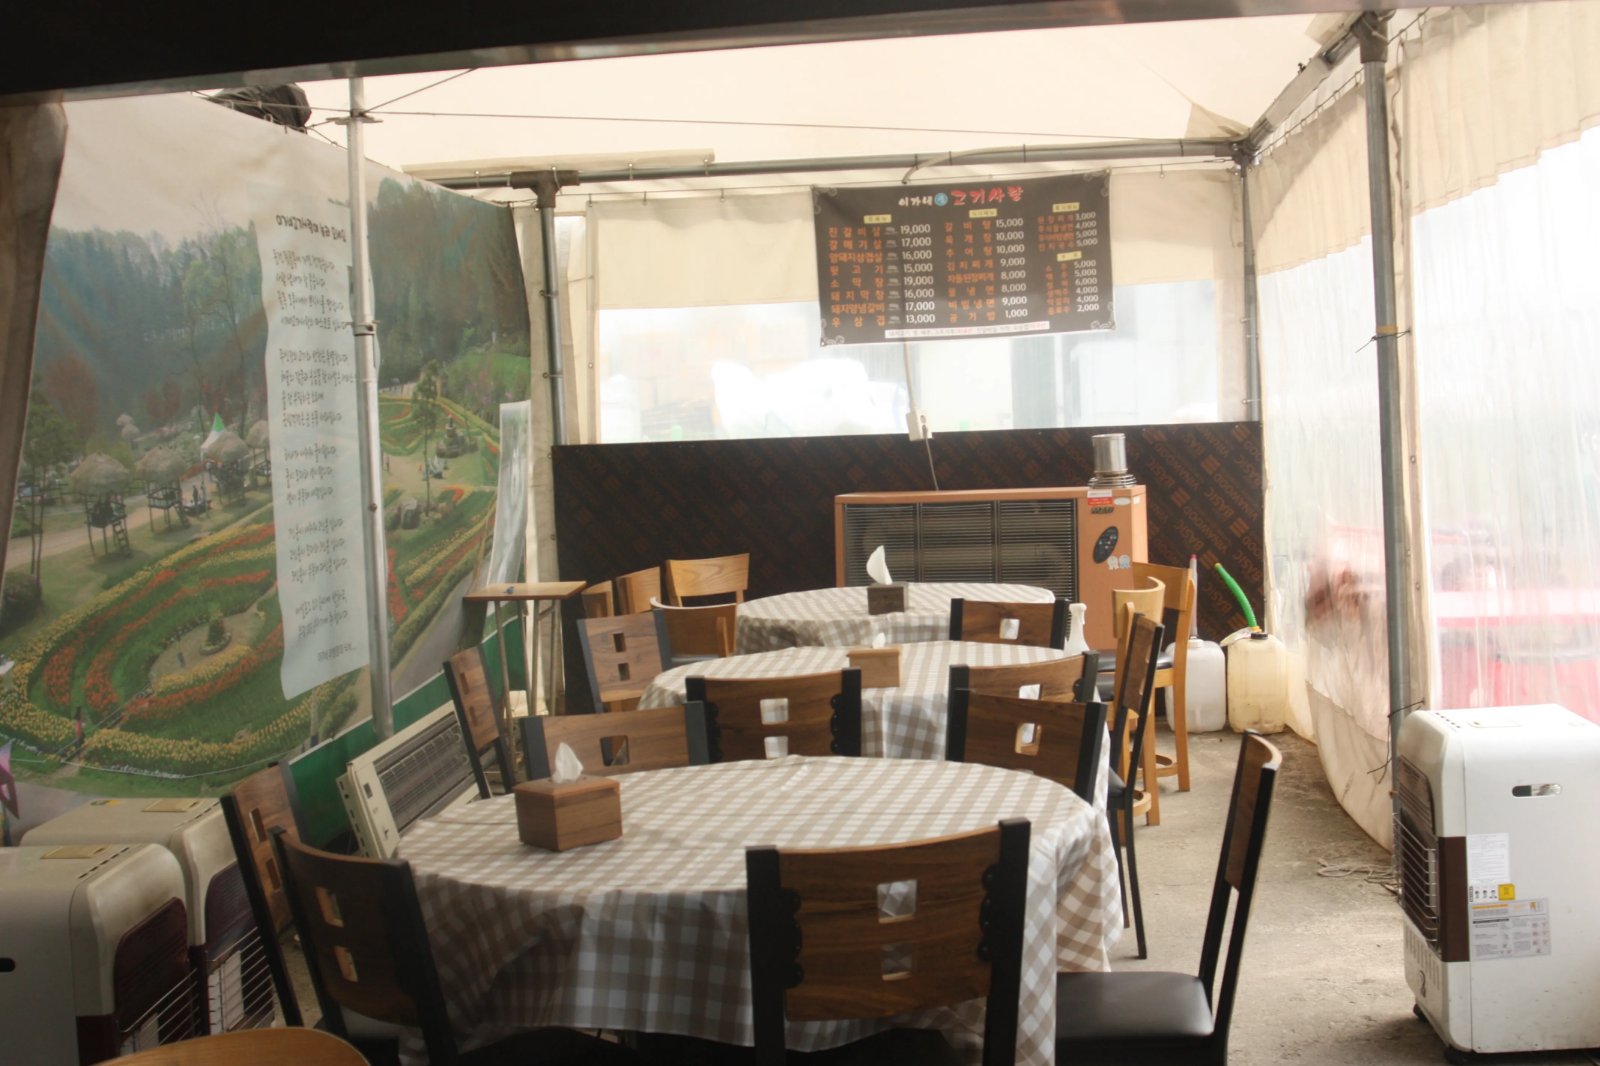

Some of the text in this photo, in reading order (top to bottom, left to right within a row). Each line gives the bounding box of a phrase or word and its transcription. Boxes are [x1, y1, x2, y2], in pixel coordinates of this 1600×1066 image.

[951, 185, 1024, 205] 고기사랑
[996, 218, 1024, 228] 15,000
[900, 224, 931, 235] 19,000
[996, 231, 1024, 241] 10,000
[901, 237, 932, 248] 17,000
[996, 244, 1025, 254] 10,000
[902, 250, 932, 260] 16,000
[1000, 257, 1025, 267] 9,000
[1074, 260, 1097, 269] 5,000
[903, 263, 933, 273] 15,000
[1074, 268, 1097, 277] 5,000
[1001, 270, 1026, 280] 8,000
[903, 276, 934, 286] 19,000
[1075, 278, 1098, 286] 6,000
[1001, 283, 1027, 293] 8,000
[1076, 286, 1098, 294] 4,000
[904, 289, 934, 299] 16,000
[1076, 295, 1099, 303] 4,000
[1002, 296, 1027, 306] 9,000
[905, 302, 935, 312] 17,000
[1077, 303, 1099, 312] 2,000
[906, 314, 936, 324] 13,000
[1005, 309, 1028, 319] 1,000
